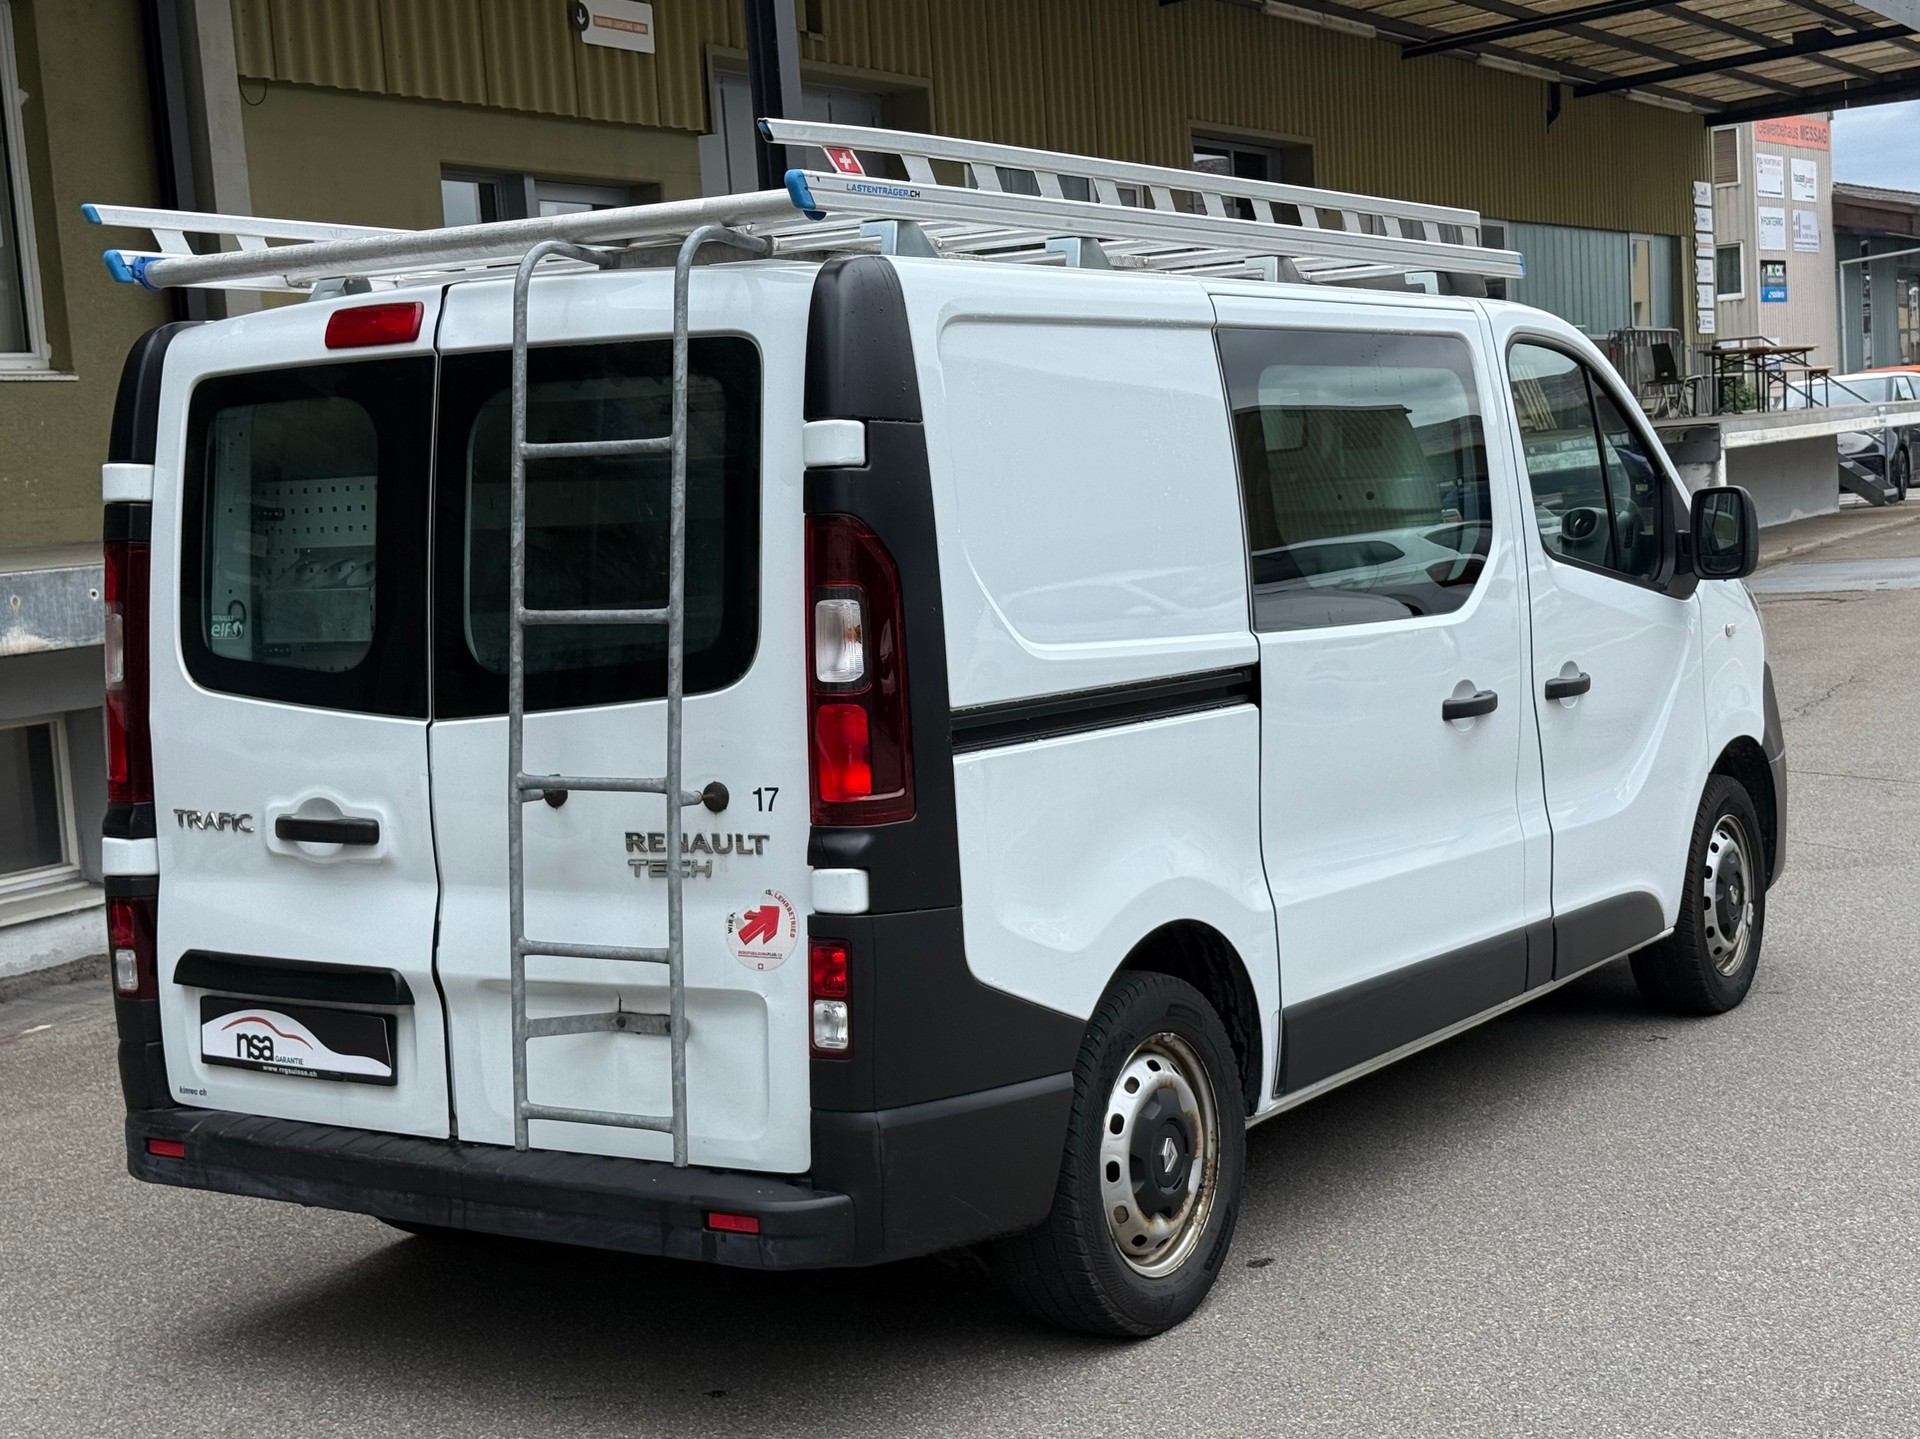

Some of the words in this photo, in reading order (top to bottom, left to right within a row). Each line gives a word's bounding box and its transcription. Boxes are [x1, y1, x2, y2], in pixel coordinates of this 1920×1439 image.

[846, 183, 921, 198] LASTENTRÄGER.CH
[211, 622, 232, 637] elf
[752, 787, 779, 812] 17
[173, 808, 255, 833] TRAFIC
[236, 1033, 274, 1062] nsa
[275, 1055, 304, 1066] GARANTIE
